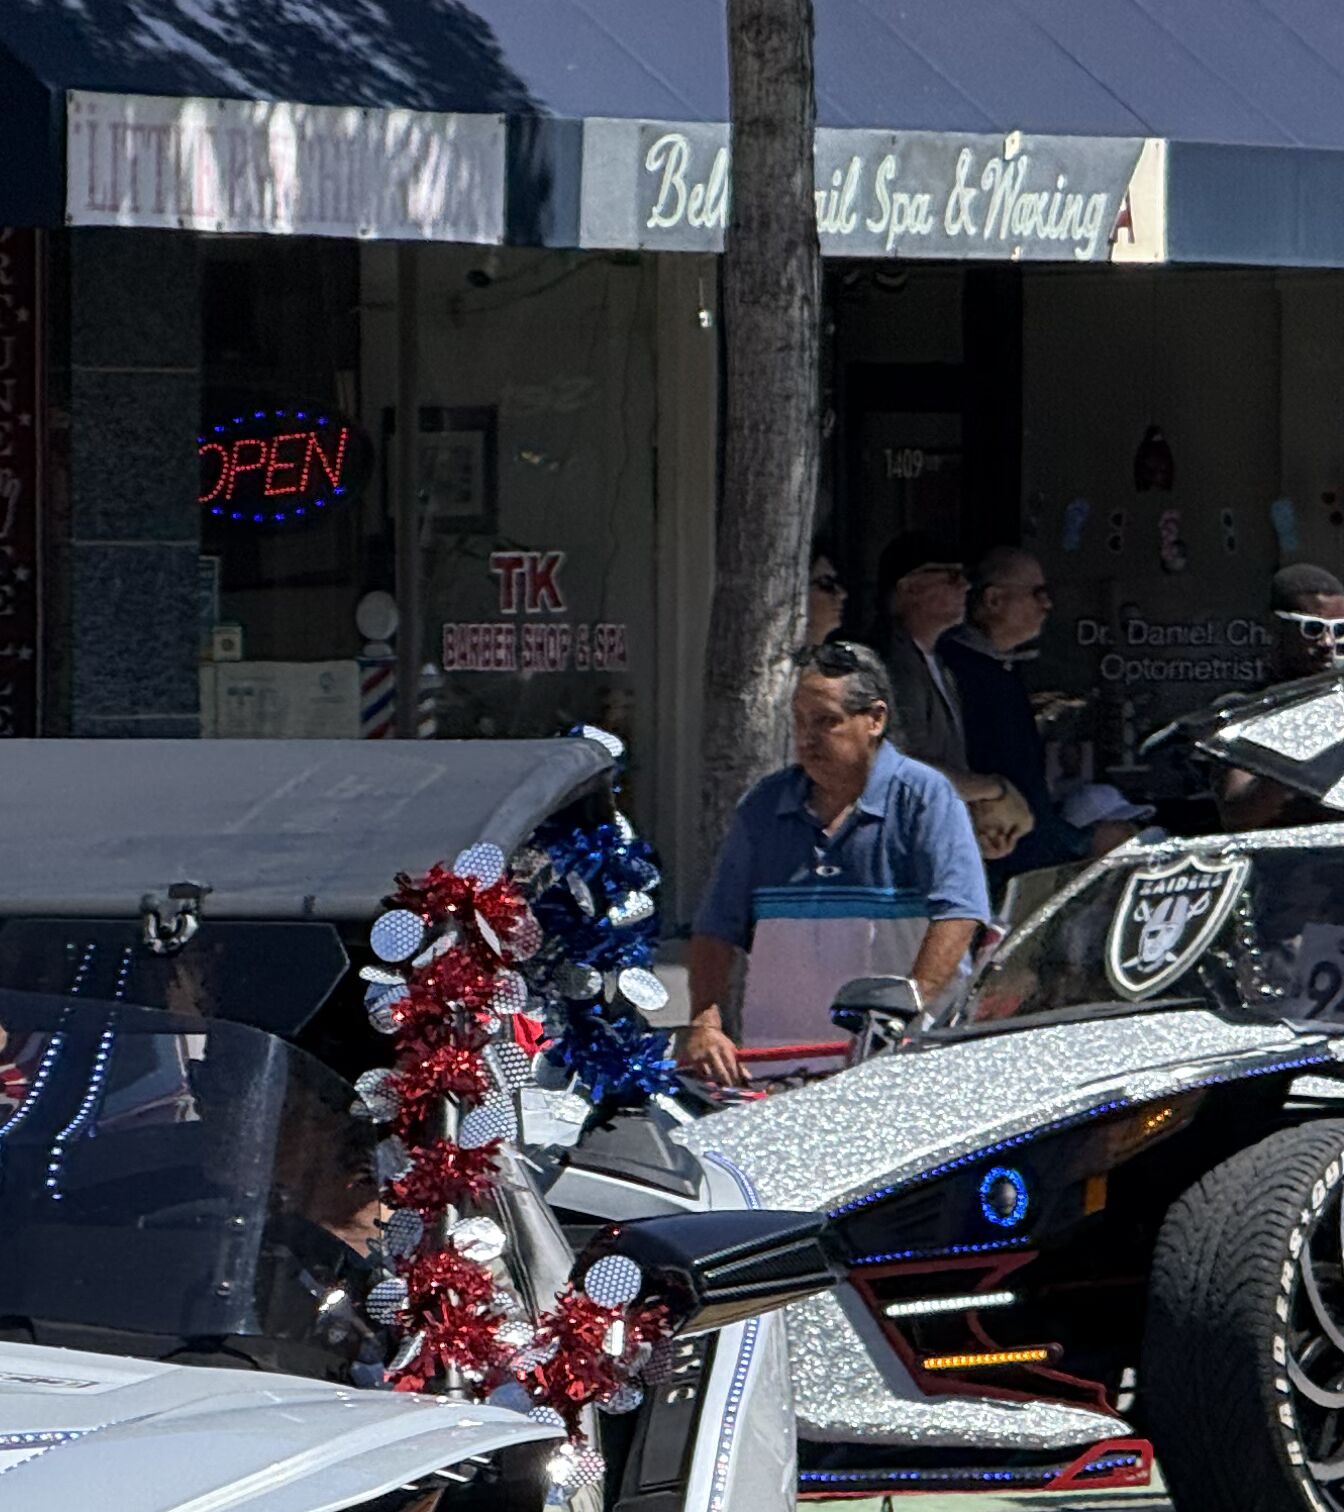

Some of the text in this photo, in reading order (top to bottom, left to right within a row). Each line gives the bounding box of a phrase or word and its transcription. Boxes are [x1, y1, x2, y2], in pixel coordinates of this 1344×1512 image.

[866, 153, 936, 252] Spa
[944, 147, 977, 239] &
[982, 155, 1111, 260] Waxing
[490, 550, 567, 614] TK
[442, 623, 628, 672] BARBER SHOP & SPA
[1076, 619, 1114, 645] Dr.
[1127, 619, 1214, 645] Daniel
[1100, 654, 1265, 685] Optometrist
